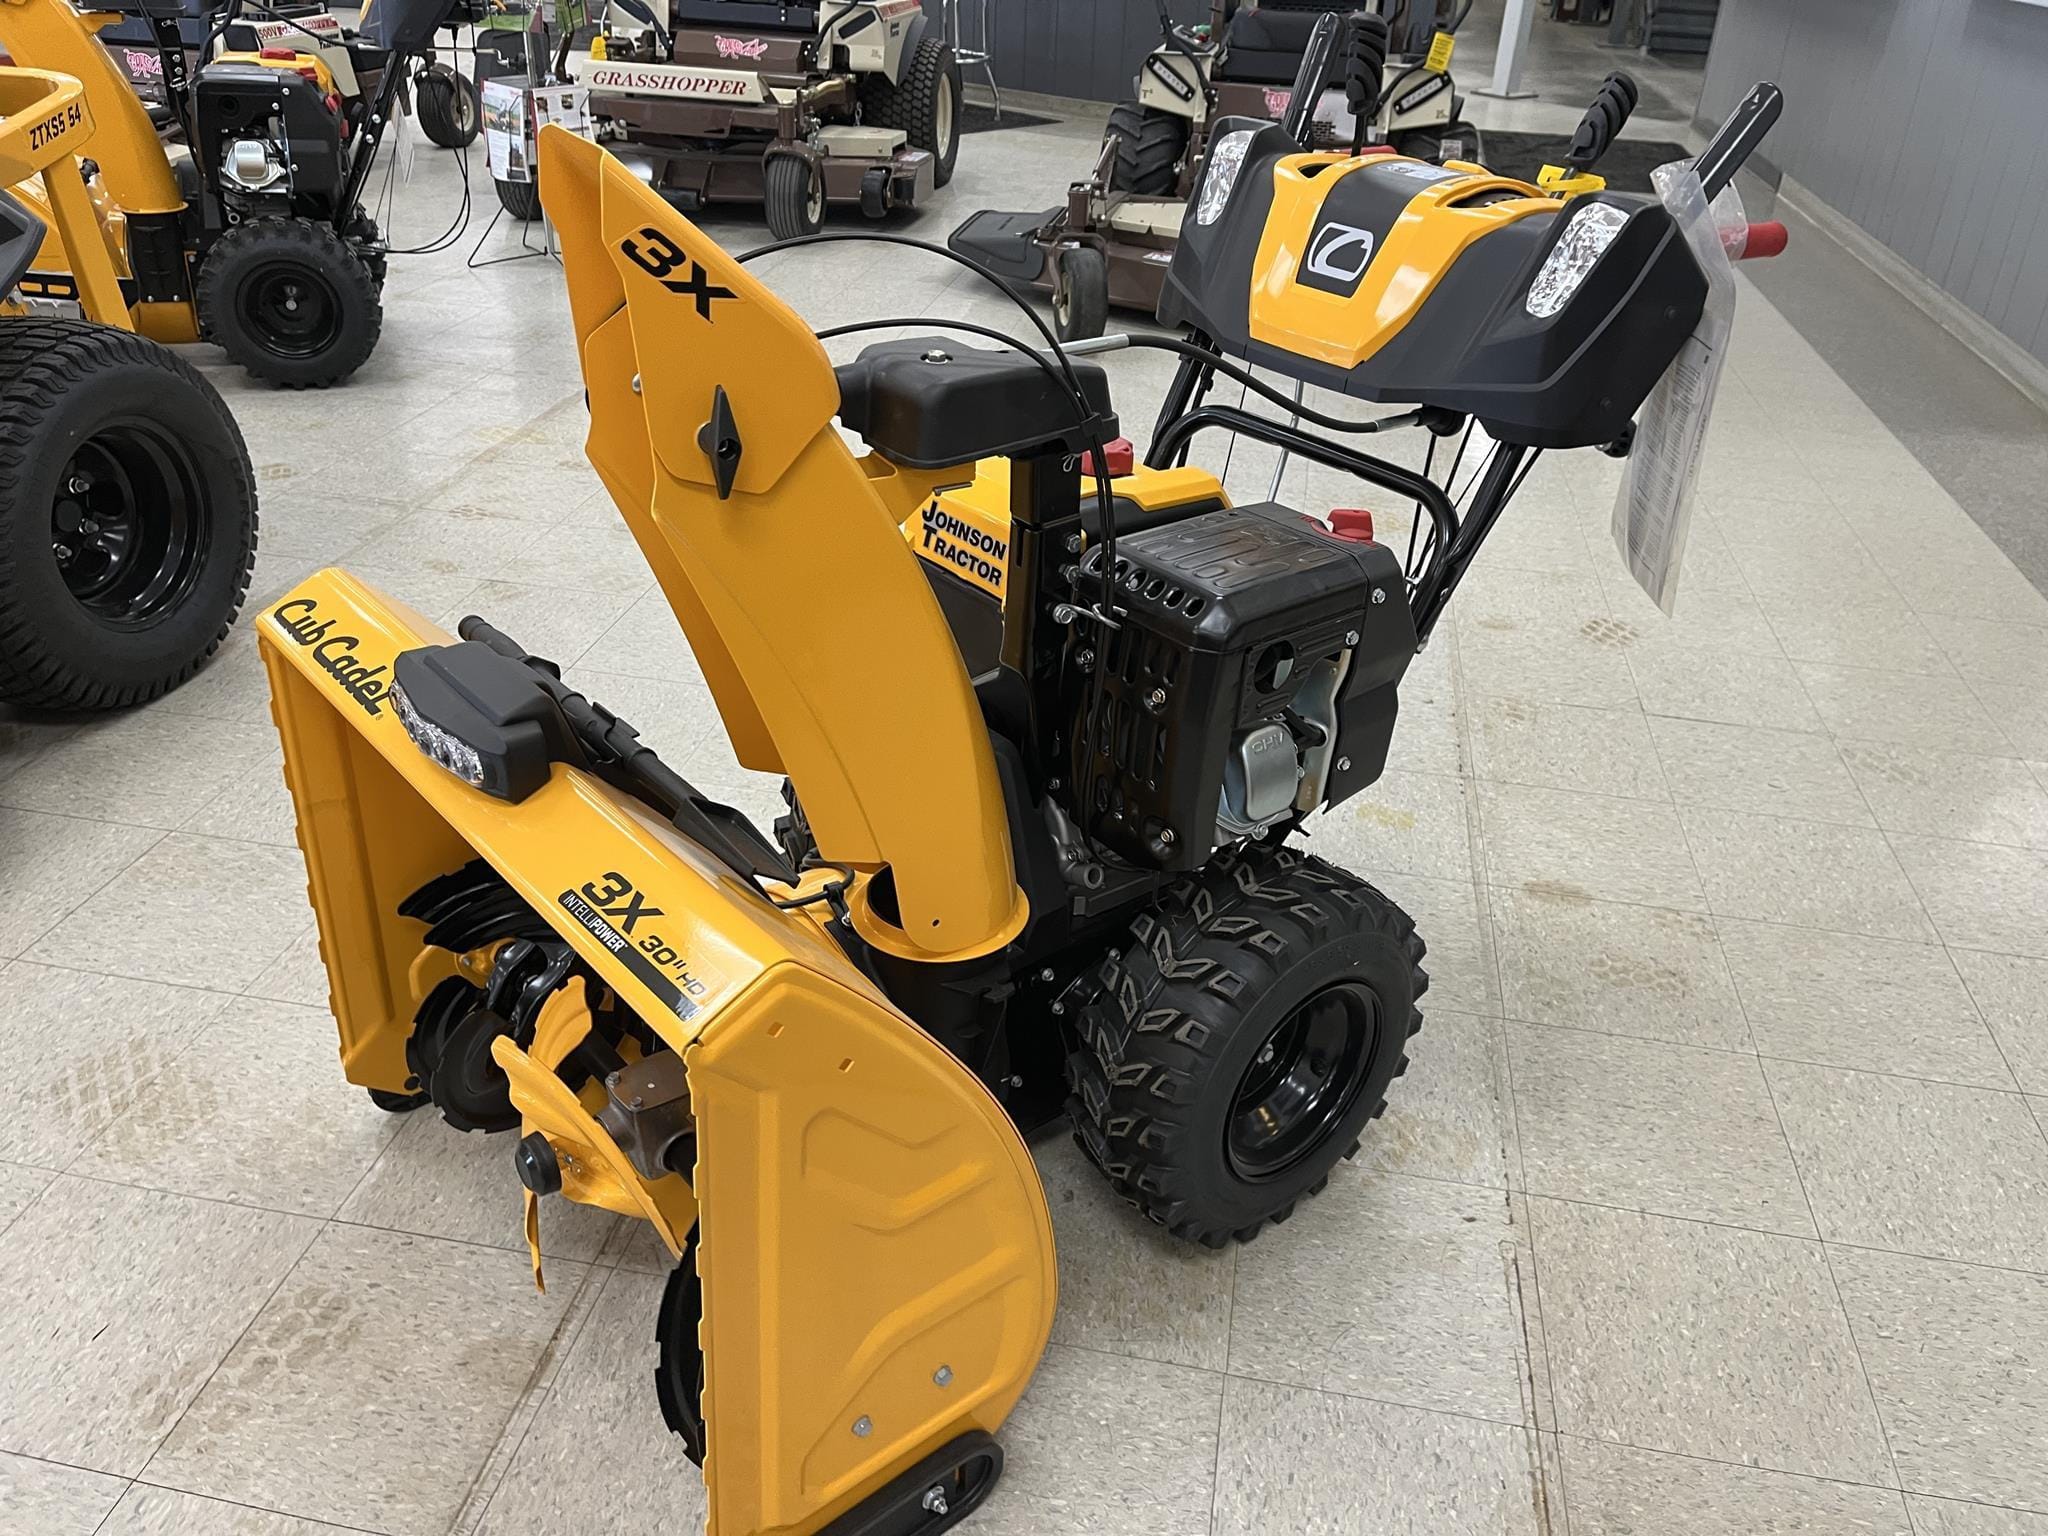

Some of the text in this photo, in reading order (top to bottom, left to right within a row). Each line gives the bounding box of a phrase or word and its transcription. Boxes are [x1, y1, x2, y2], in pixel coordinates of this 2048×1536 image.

[592, 70, 747, 96] GRASSHOPPER
[29, 102, 82, 151] ZTXS5 54
[620, 227, 739, 322] 3X
[922, 500, 1007, 561] JOHNSON
[922, 523, 1002, 587] TRACTOR
[273, 598, 390, 716] Cub Cadet
[562, 892, 627, 953] INTELLIPOWER
[581, 871, 665, 936] 3X
[675, 971, 707, 996] HD
